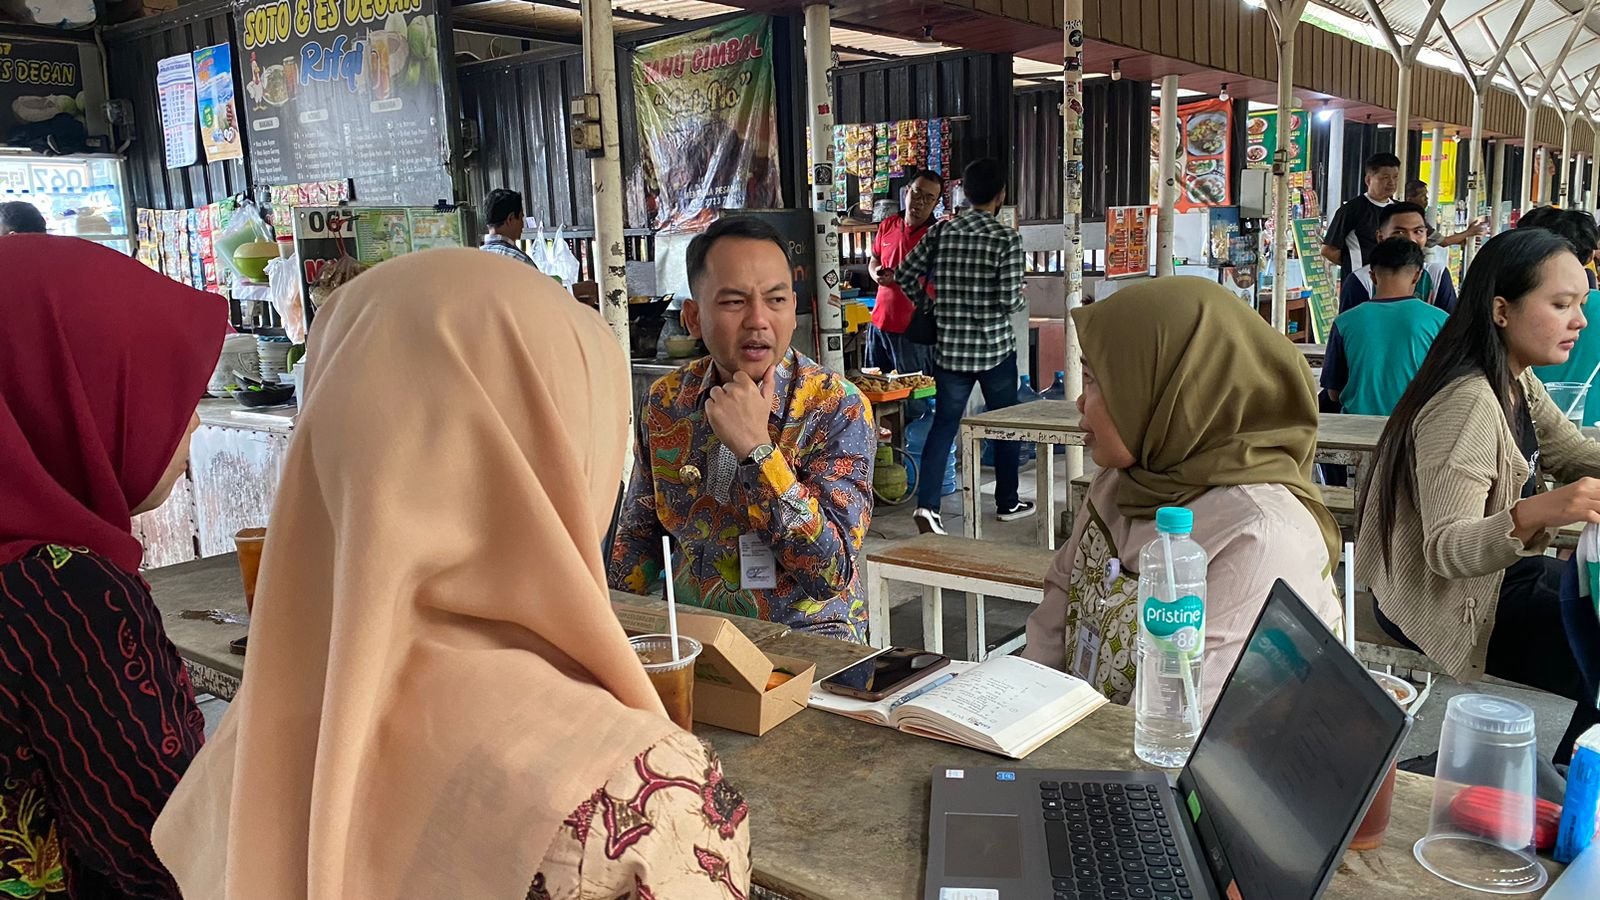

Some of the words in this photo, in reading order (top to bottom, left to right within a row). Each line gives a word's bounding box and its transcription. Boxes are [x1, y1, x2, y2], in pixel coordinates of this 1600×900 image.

[244, 1, 292, 49] SOTO
[294, 0, 311, 37] &
[314, 0, 340, 33] ES
[0, 58, 13, 82] S
[15, 59, 76, 86] DEGAN
[301, 35, 364, 93] Rifqi
[643, 55, 686, 85] TAHU
[691, 33, 763, 73] GIMBAL
[1146, 607, 1201, 624] Pristine
